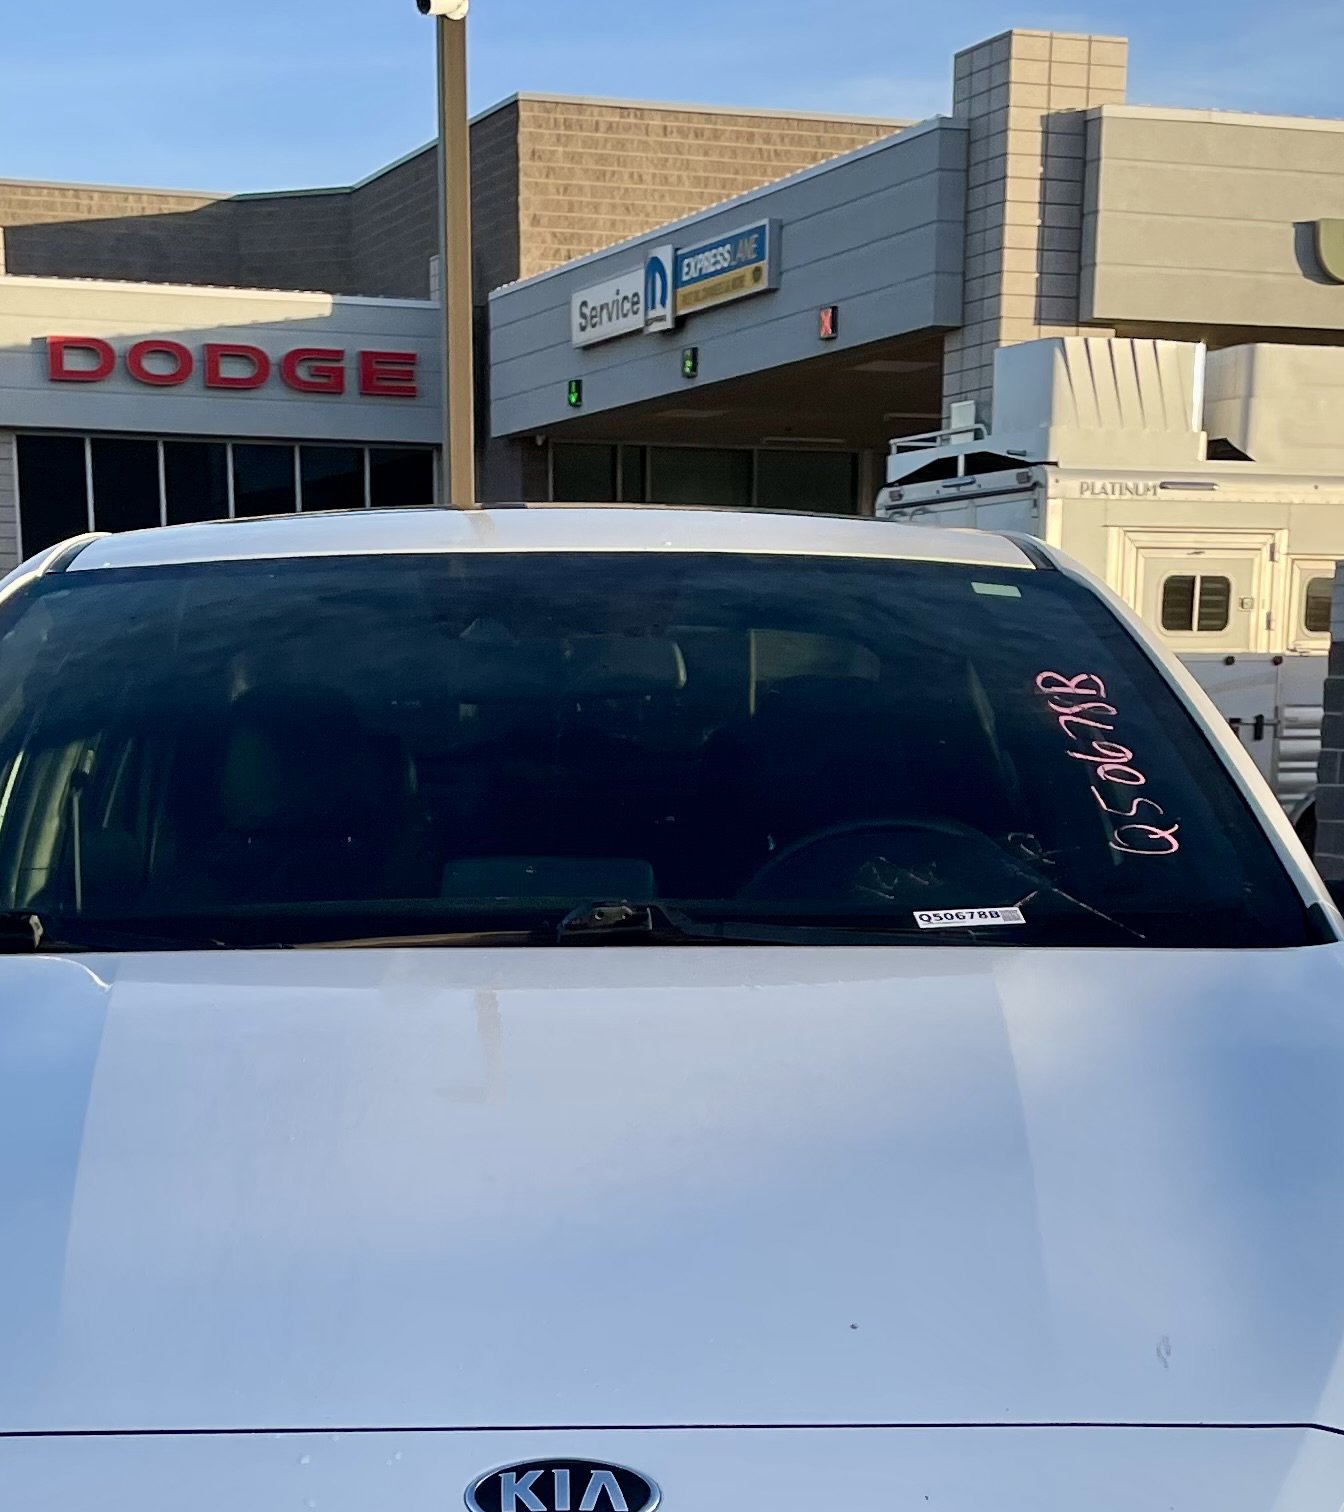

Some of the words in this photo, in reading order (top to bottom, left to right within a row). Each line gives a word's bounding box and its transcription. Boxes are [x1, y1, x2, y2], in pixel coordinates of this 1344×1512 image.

[579, 288, 641, 332] Service
[46, 335, 419, 397] DODGE
[1079, 481, 1158, 497] PLATINUM
[918, 909, 1001, 924] Q50678B
